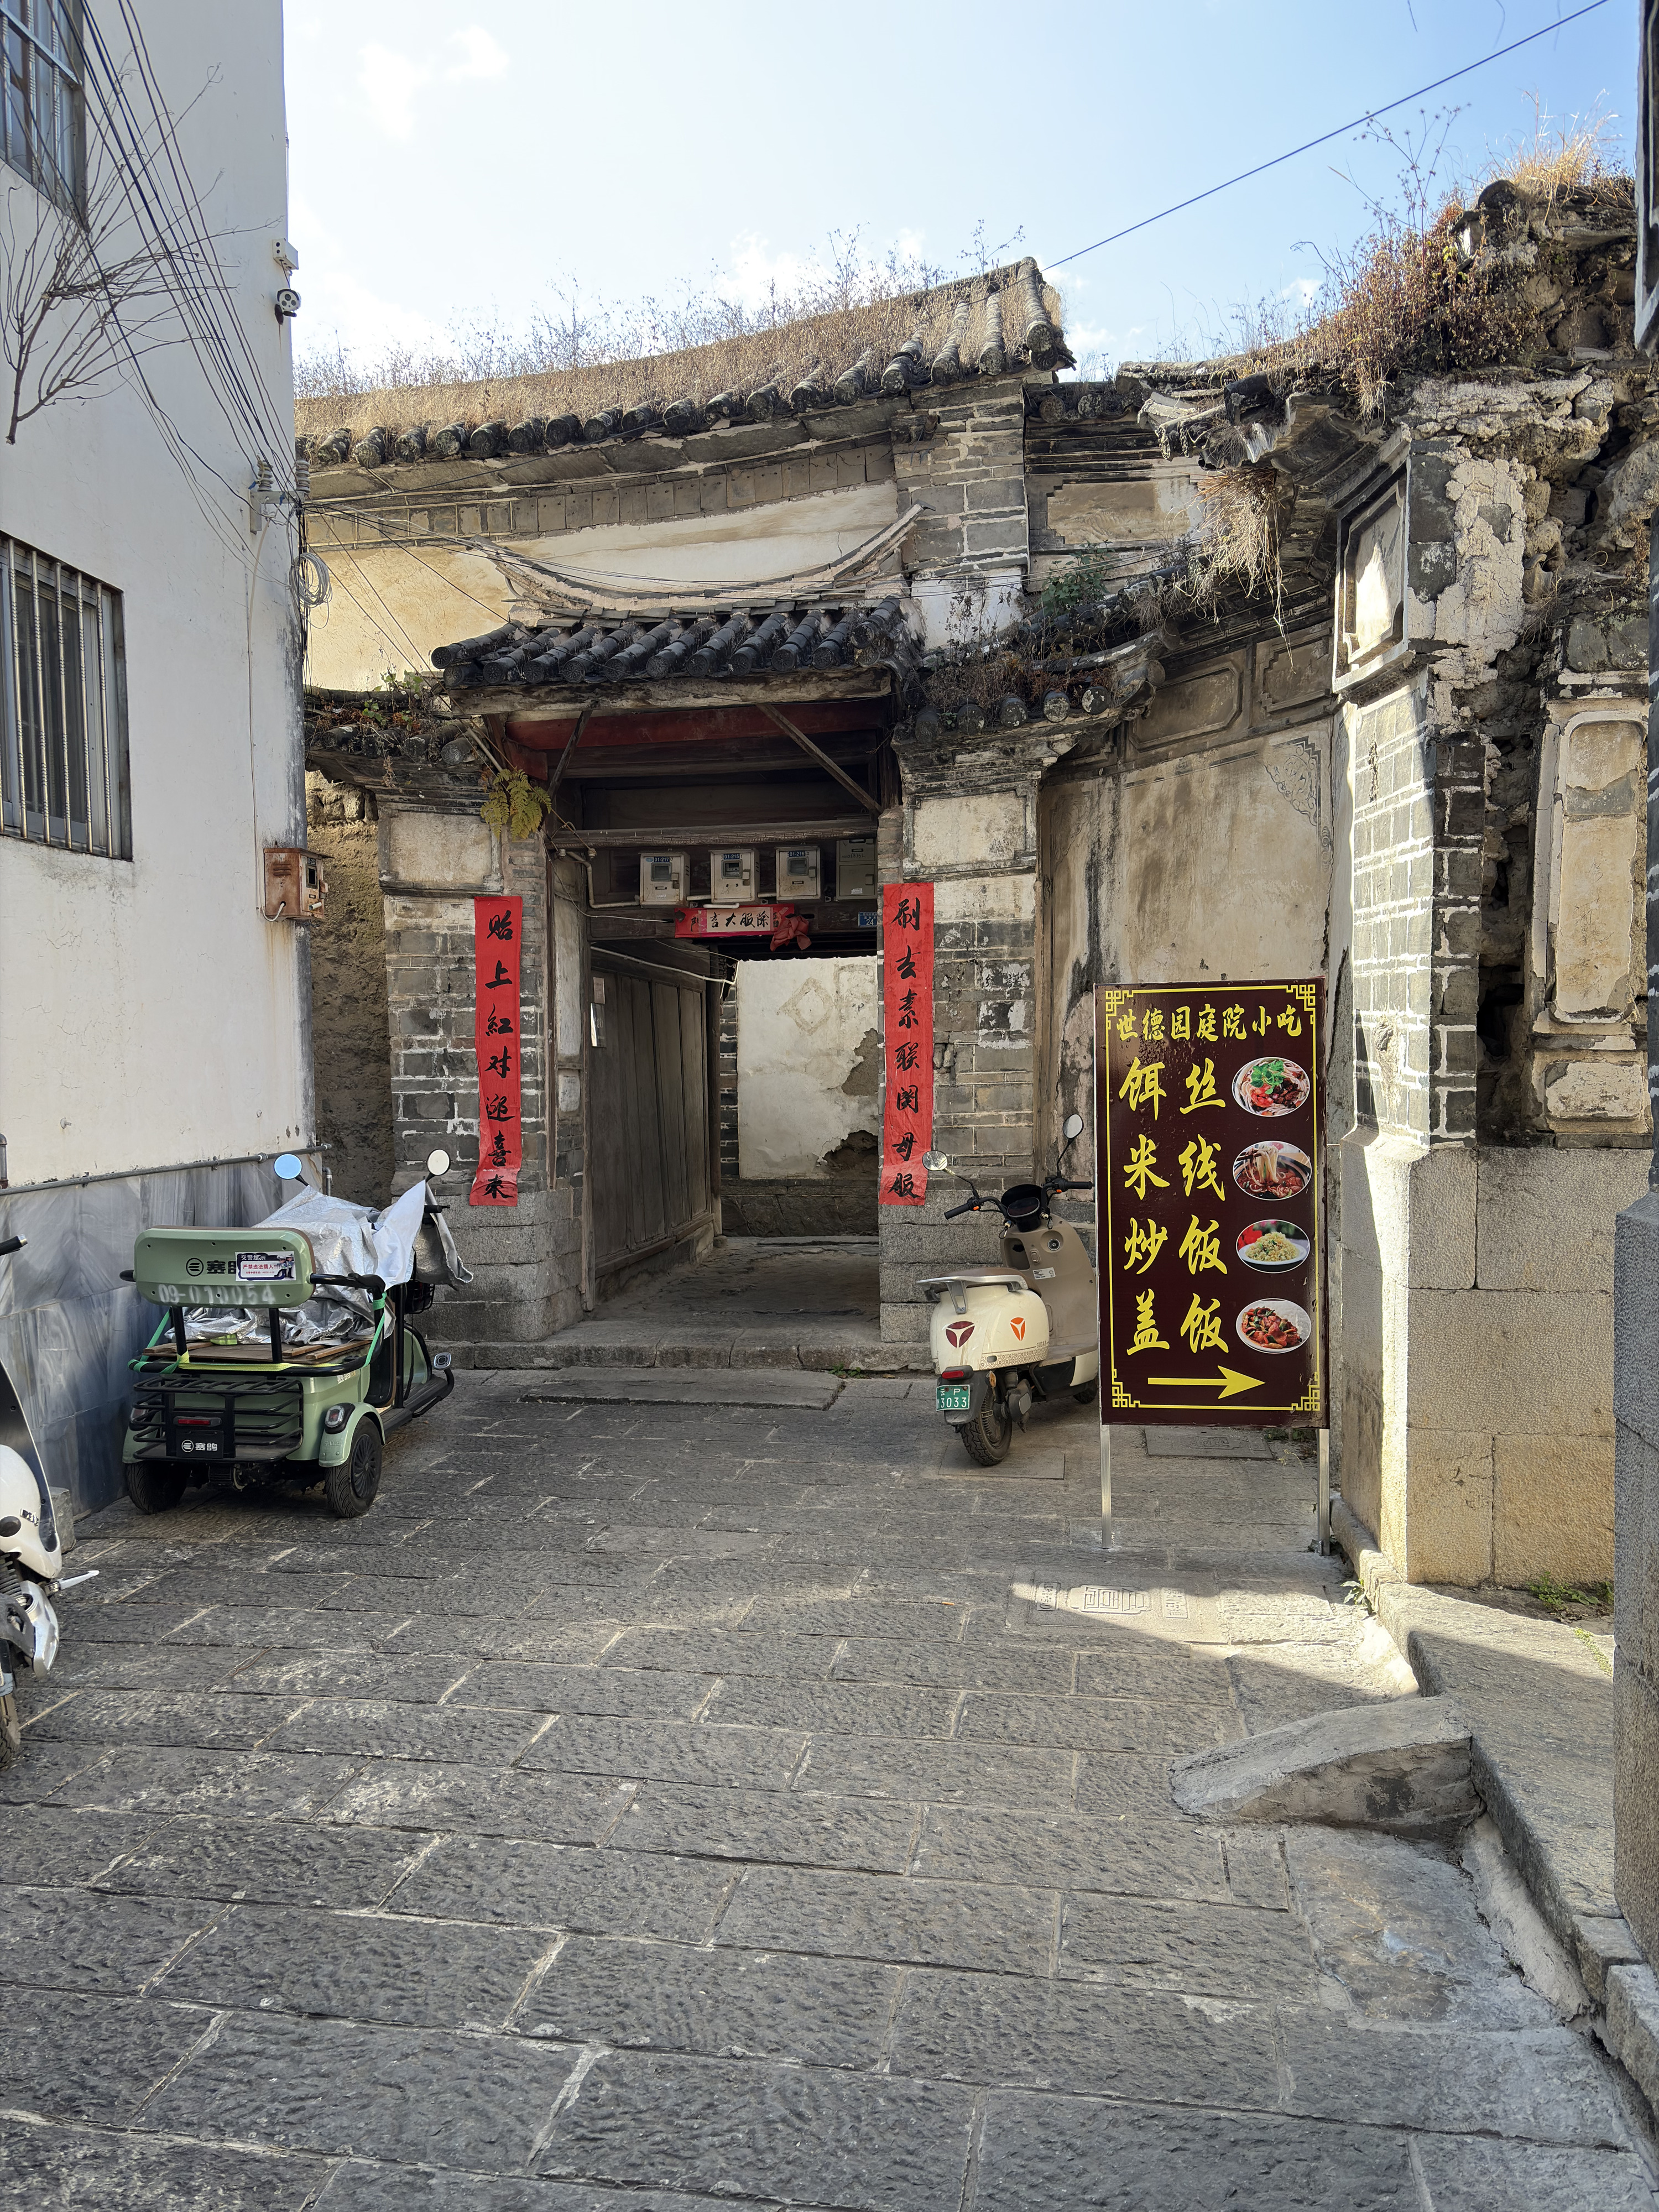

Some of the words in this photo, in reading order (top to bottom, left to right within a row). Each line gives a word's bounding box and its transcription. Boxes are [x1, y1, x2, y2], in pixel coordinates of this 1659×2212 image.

[1116, 1003, 1302, 1042] 世德园庭院小吃
[1119, 1056, 1226, 1121] 饵丝
[1123, 1134, 1226, 1202] 米线
[1123, 1214, 1229, 1275] 炒饭
[1127, 1288, 1229, 1357] 盖饭
[195, 1442, 217, 1451] 赛鸽
